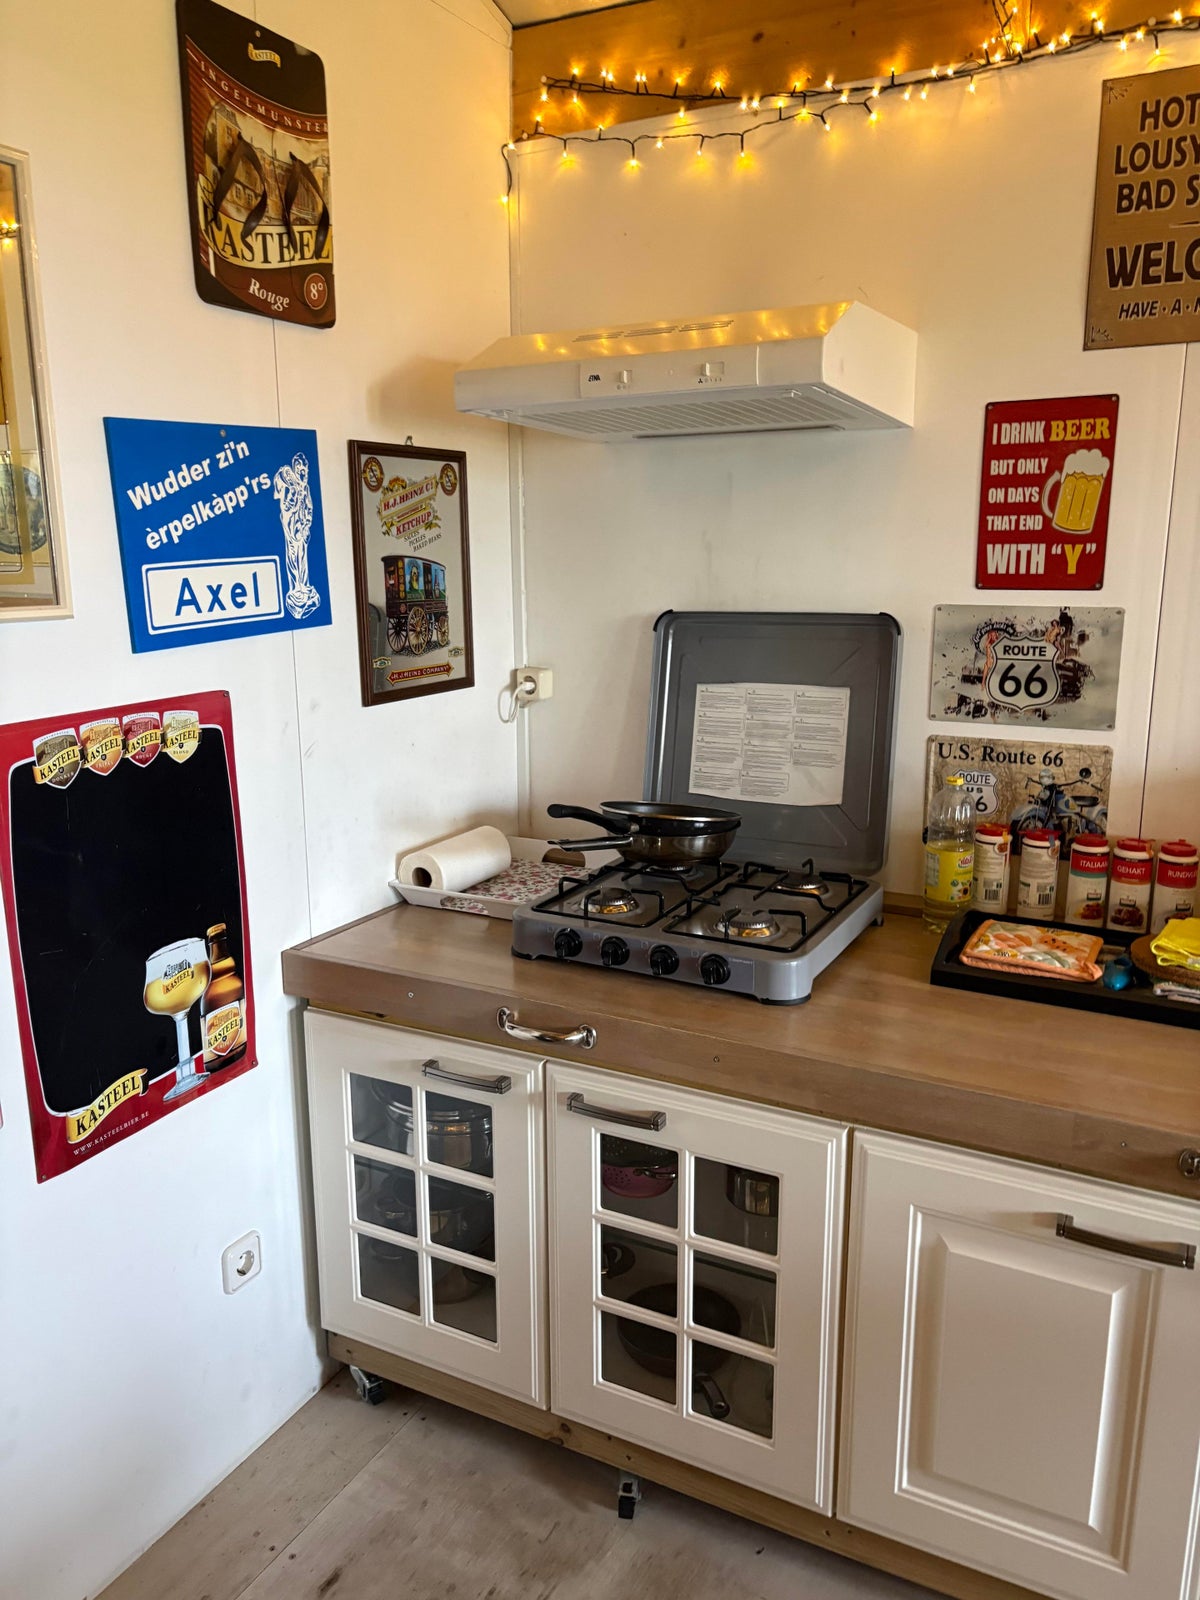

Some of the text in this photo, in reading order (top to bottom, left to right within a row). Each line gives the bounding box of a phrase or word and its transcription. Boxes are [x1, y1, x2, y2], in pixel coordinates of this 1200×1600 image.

[1139, 93, 1200, 132] HOT
[1114, 134, 1200, 175] LOUSY
[1116, 178, 1176, 214] BAD
[248, 278, 290, 312] Rouge
[1119, 300, 1158, 319] HAVE
[992, 417, 1111, 445] I DRINK BEER
[127, 440, 250, 511] Wudder zi'n
[990, 457, 1049, 476] BUT ONLY
[399, 484, 424, 504] HEINZ
[988, 486, 1040, 504] ON DAYS
[396, 510, 432, 536] KETCHUP
[986, 514, 1043, 531] THAT END
[986, 543, 1046, 575] WITH
[174, 571, 261, 617] Axel
[1002, 645, 1047, 657] ROUTE
[998, 663, 1048, 699] 66
[83, 737, 121, 765] KASTEEL
[124, 731, 160, 755] KASTEEL
[163, 729, 198, 749] KASTEEL
[39, 747, 79, 781] KASTEEL
[938, 742, 1064, 767] U.S. Route 66
[1117, 864, 1146, 875] GEHAKT
[165, 970, 190, 993] KASTEEL
[208, 1017, 239, 1048] KASTEEL
[75, 1075, 140, 1137] KASTEEL
